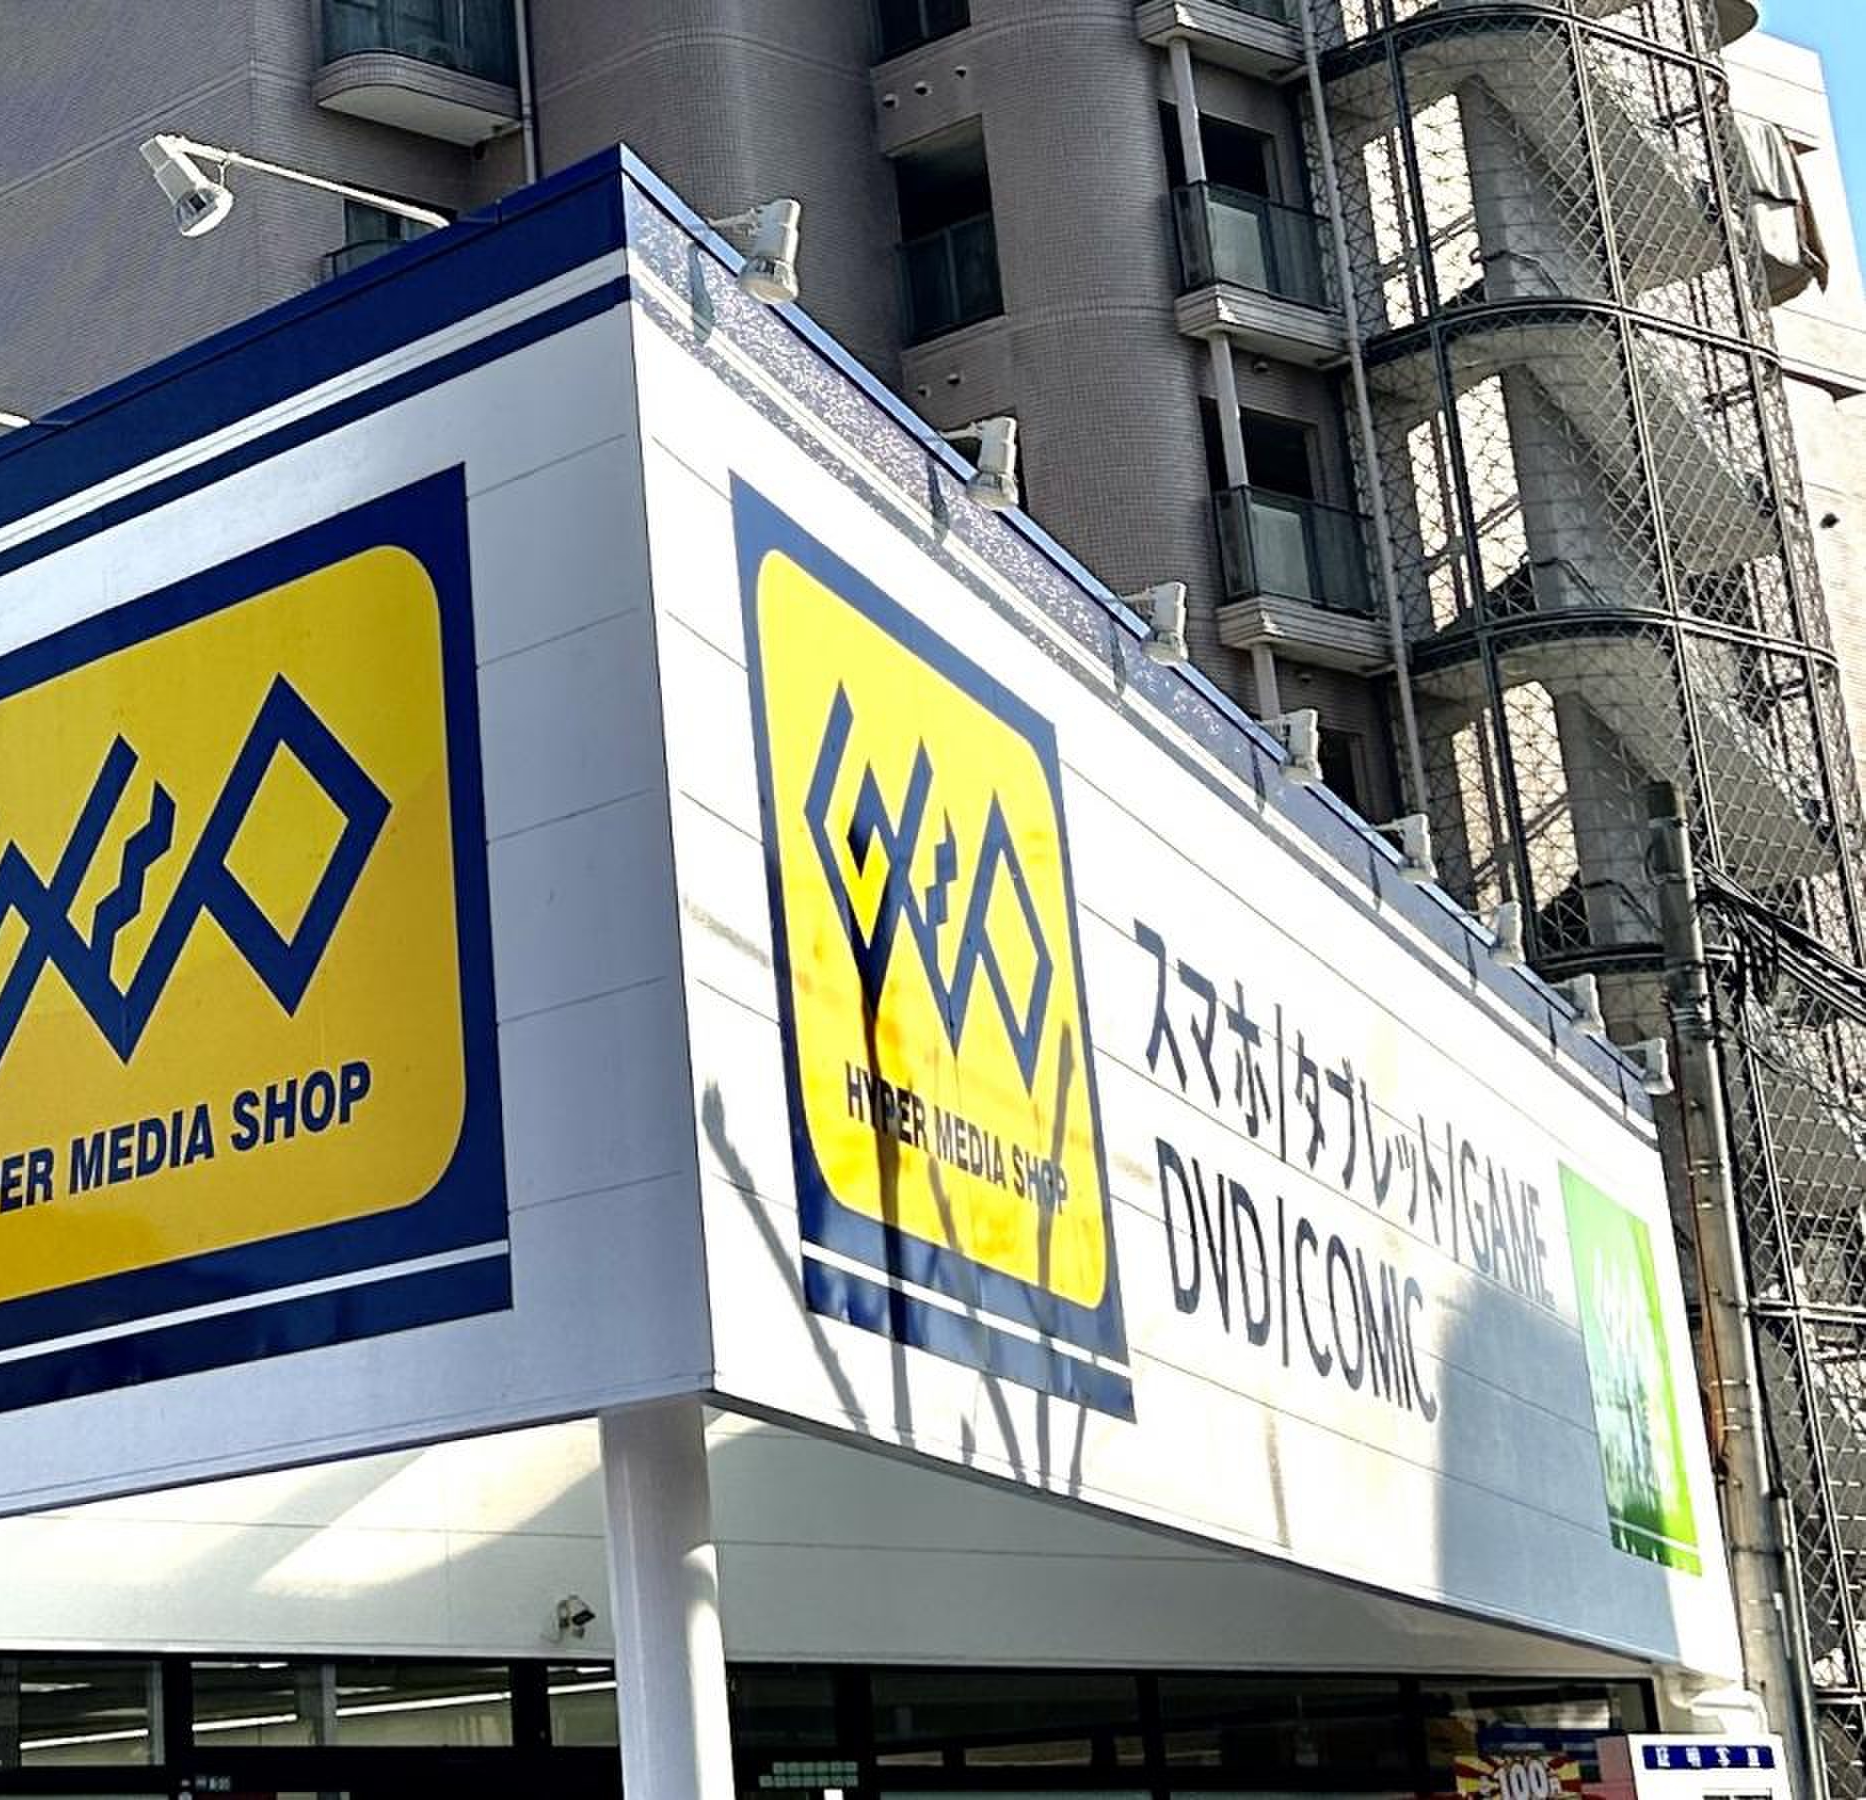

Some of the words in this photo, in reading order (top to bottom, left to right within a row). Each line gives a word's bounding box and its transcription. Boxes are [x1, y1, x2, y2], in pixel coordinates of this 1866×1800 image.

[69, 1104, 215, 1191] MEDIA
[233, 1060, 372, 1153] SHOP
[845, 1061, 928, 1150] HYPER
[934, 1109, 1007, 1192] MEDIA
[1012, 1140, 1068, 1216] SHOP
